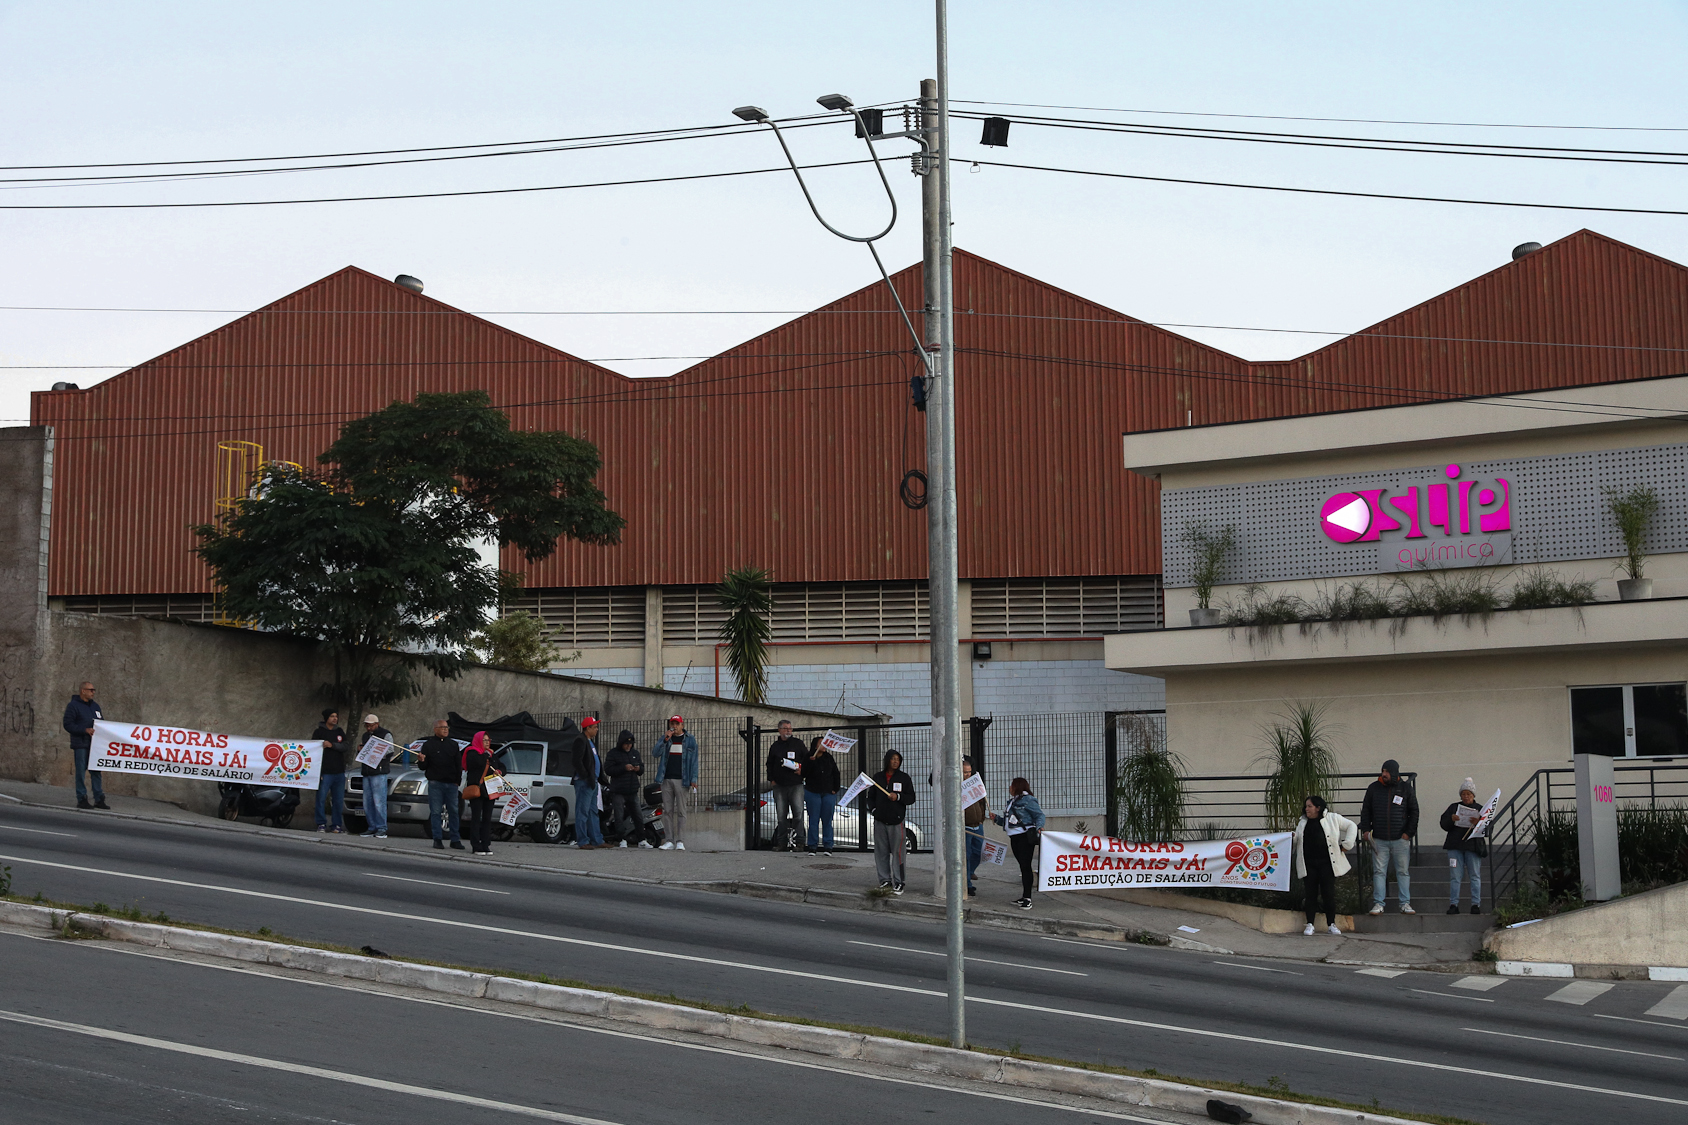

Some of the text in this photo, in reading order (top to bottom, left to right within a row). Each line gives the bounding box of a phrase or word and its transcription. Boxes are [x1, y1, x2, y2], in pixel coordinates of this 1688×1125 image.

[1398, 541, 1493, 568] química
[130, 726, 229, 748] 40 HORAS
[106, 741, 248, 769] SEMANAIS JÁ!
[97, 758, 254, 781] SEM REDUÇÃO DE SALÁRIO!
[1594, 785, 1613, 803] 1060
[1079, 835, 1102, 852] 40
[1055, 854, 1208, 872] SEMANAIS JÁ!
[1047, 872, 1212, 887] SEM REDUÇÃO DE SALÁRIO!
